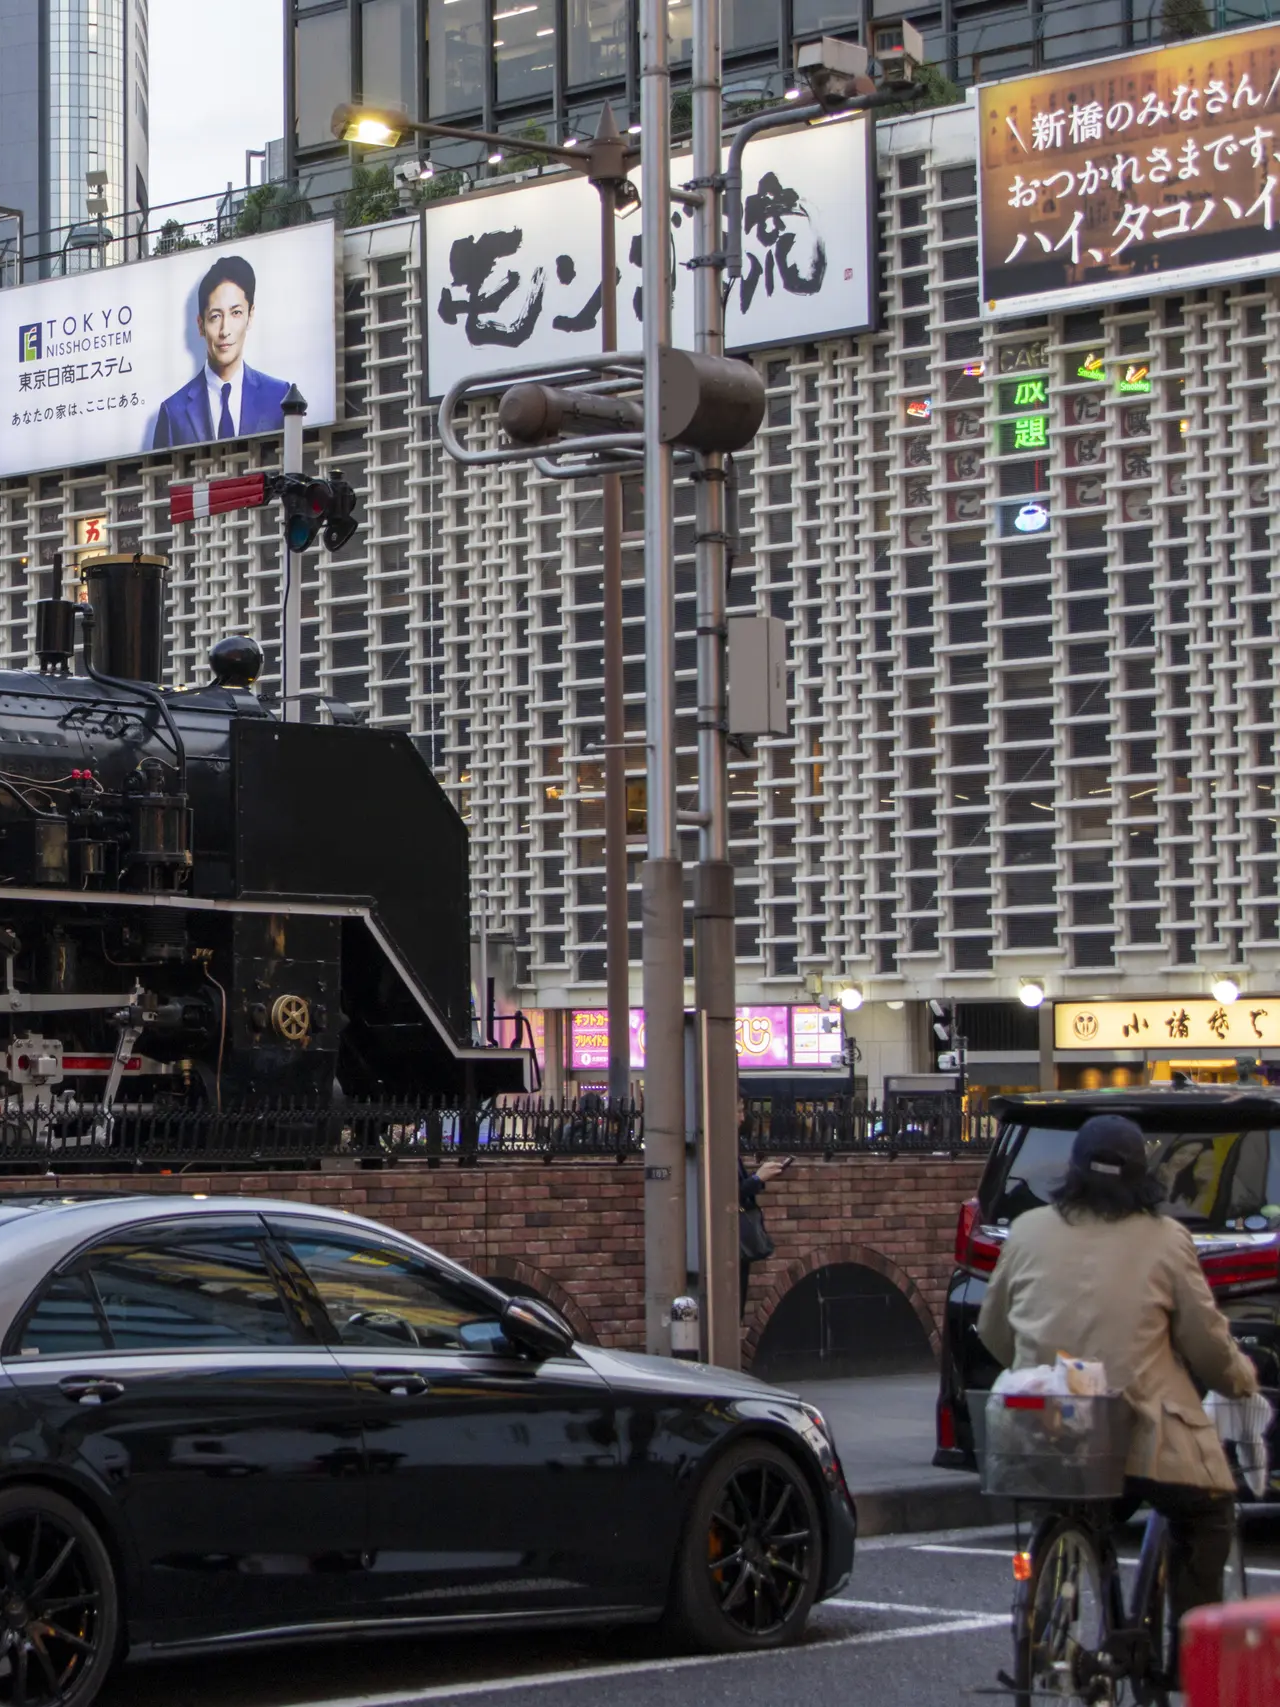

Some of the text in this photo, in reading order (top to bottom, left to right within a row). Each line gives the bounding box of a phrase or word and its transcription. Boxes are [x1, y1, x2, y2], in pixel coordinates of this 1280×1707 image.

[46, 305, 132, 339] TOKYO
[46, 330, 132, 358] NISSHO ESTEM
[18, 356, 132, 392] 東京日商エステム
[1077, 367, 1106, 381] Smoking
[1120, 381, 1149, 392] Smoking
[11, 393, 146, 427] あなたの家は、ここにある。
